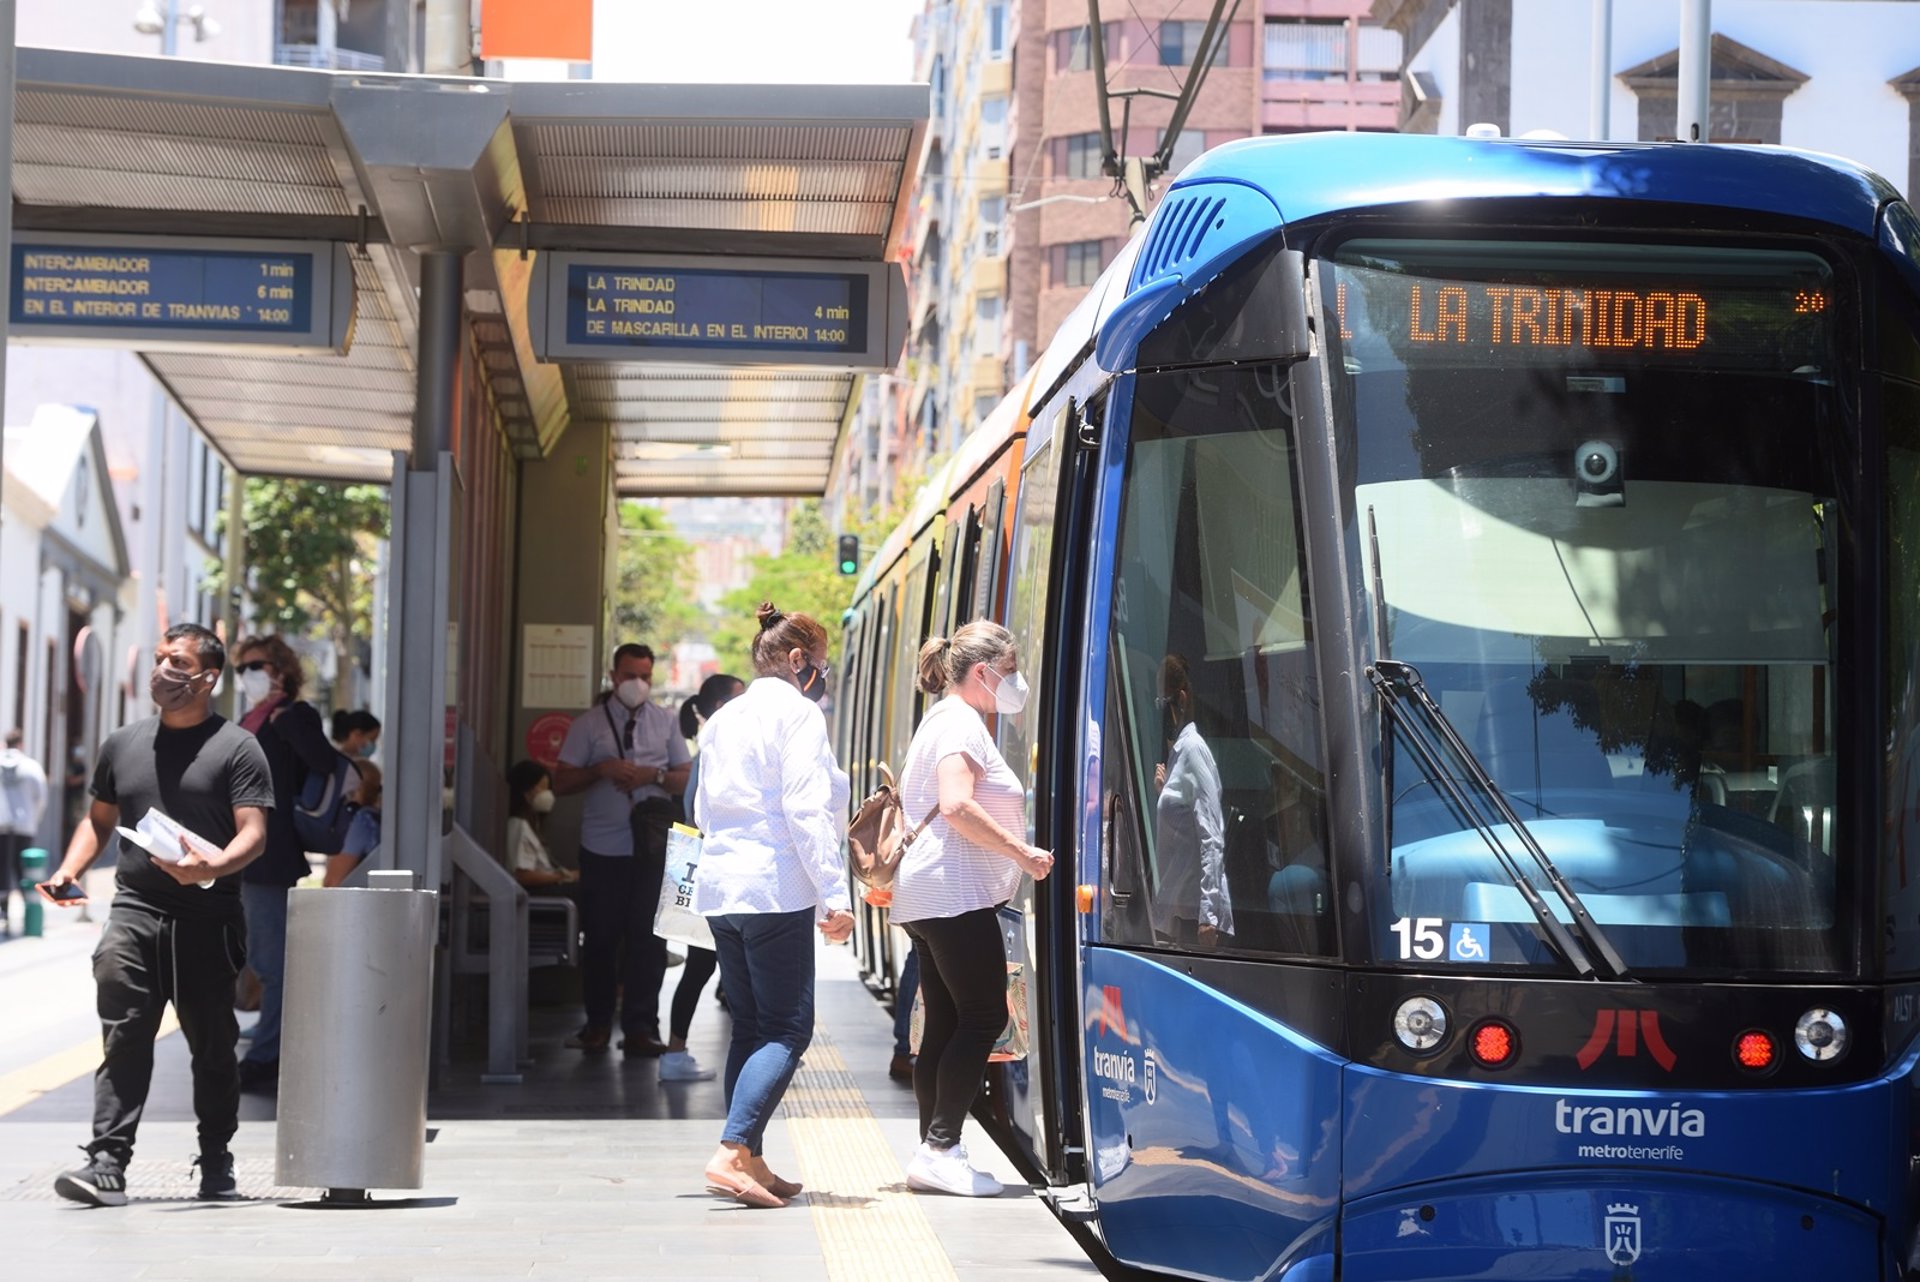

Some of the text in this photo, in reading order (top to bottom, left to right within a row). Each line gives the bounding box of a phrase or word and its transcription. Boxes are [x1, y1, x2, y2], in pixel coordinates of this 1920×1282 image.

[24, 255, 150, 273] INTERCAMBIADOR
[260, 263, 294, 277] 1 min
[24, 276, 149, 295] INTERCAMBIADOR
[257, 285, 293, 299] 6 min
[587, 276, 676, 293] LA TRINIDAD
[24, 299, 240, 320] EN EL INTERIOR DE TRANVIAS
[587, 298, 675, 315] LA TRINIDAD
[1795, 292, 1824, 313] 20
[257, 308, 289, 323] 14:00
[814, 305, 849, 320] 4 min
[1410, 284, 1707, 349] LA TRINIDAD
[587, 319, 605, 335] DE
[611, 320, 700, 338] MASCARILLA
[707, 323, 725, 339] EN
[731, 324, 747, 339] EL
[814, 328, 845, 343] 14:00
[1389, 917, 1444, 960] 15
[1094, 1045, 1135, 1083] tranvía
[1555, 1098, 1706, 1137] tranvía
[1578, 1145, 1684, 1161] metrotenerife
